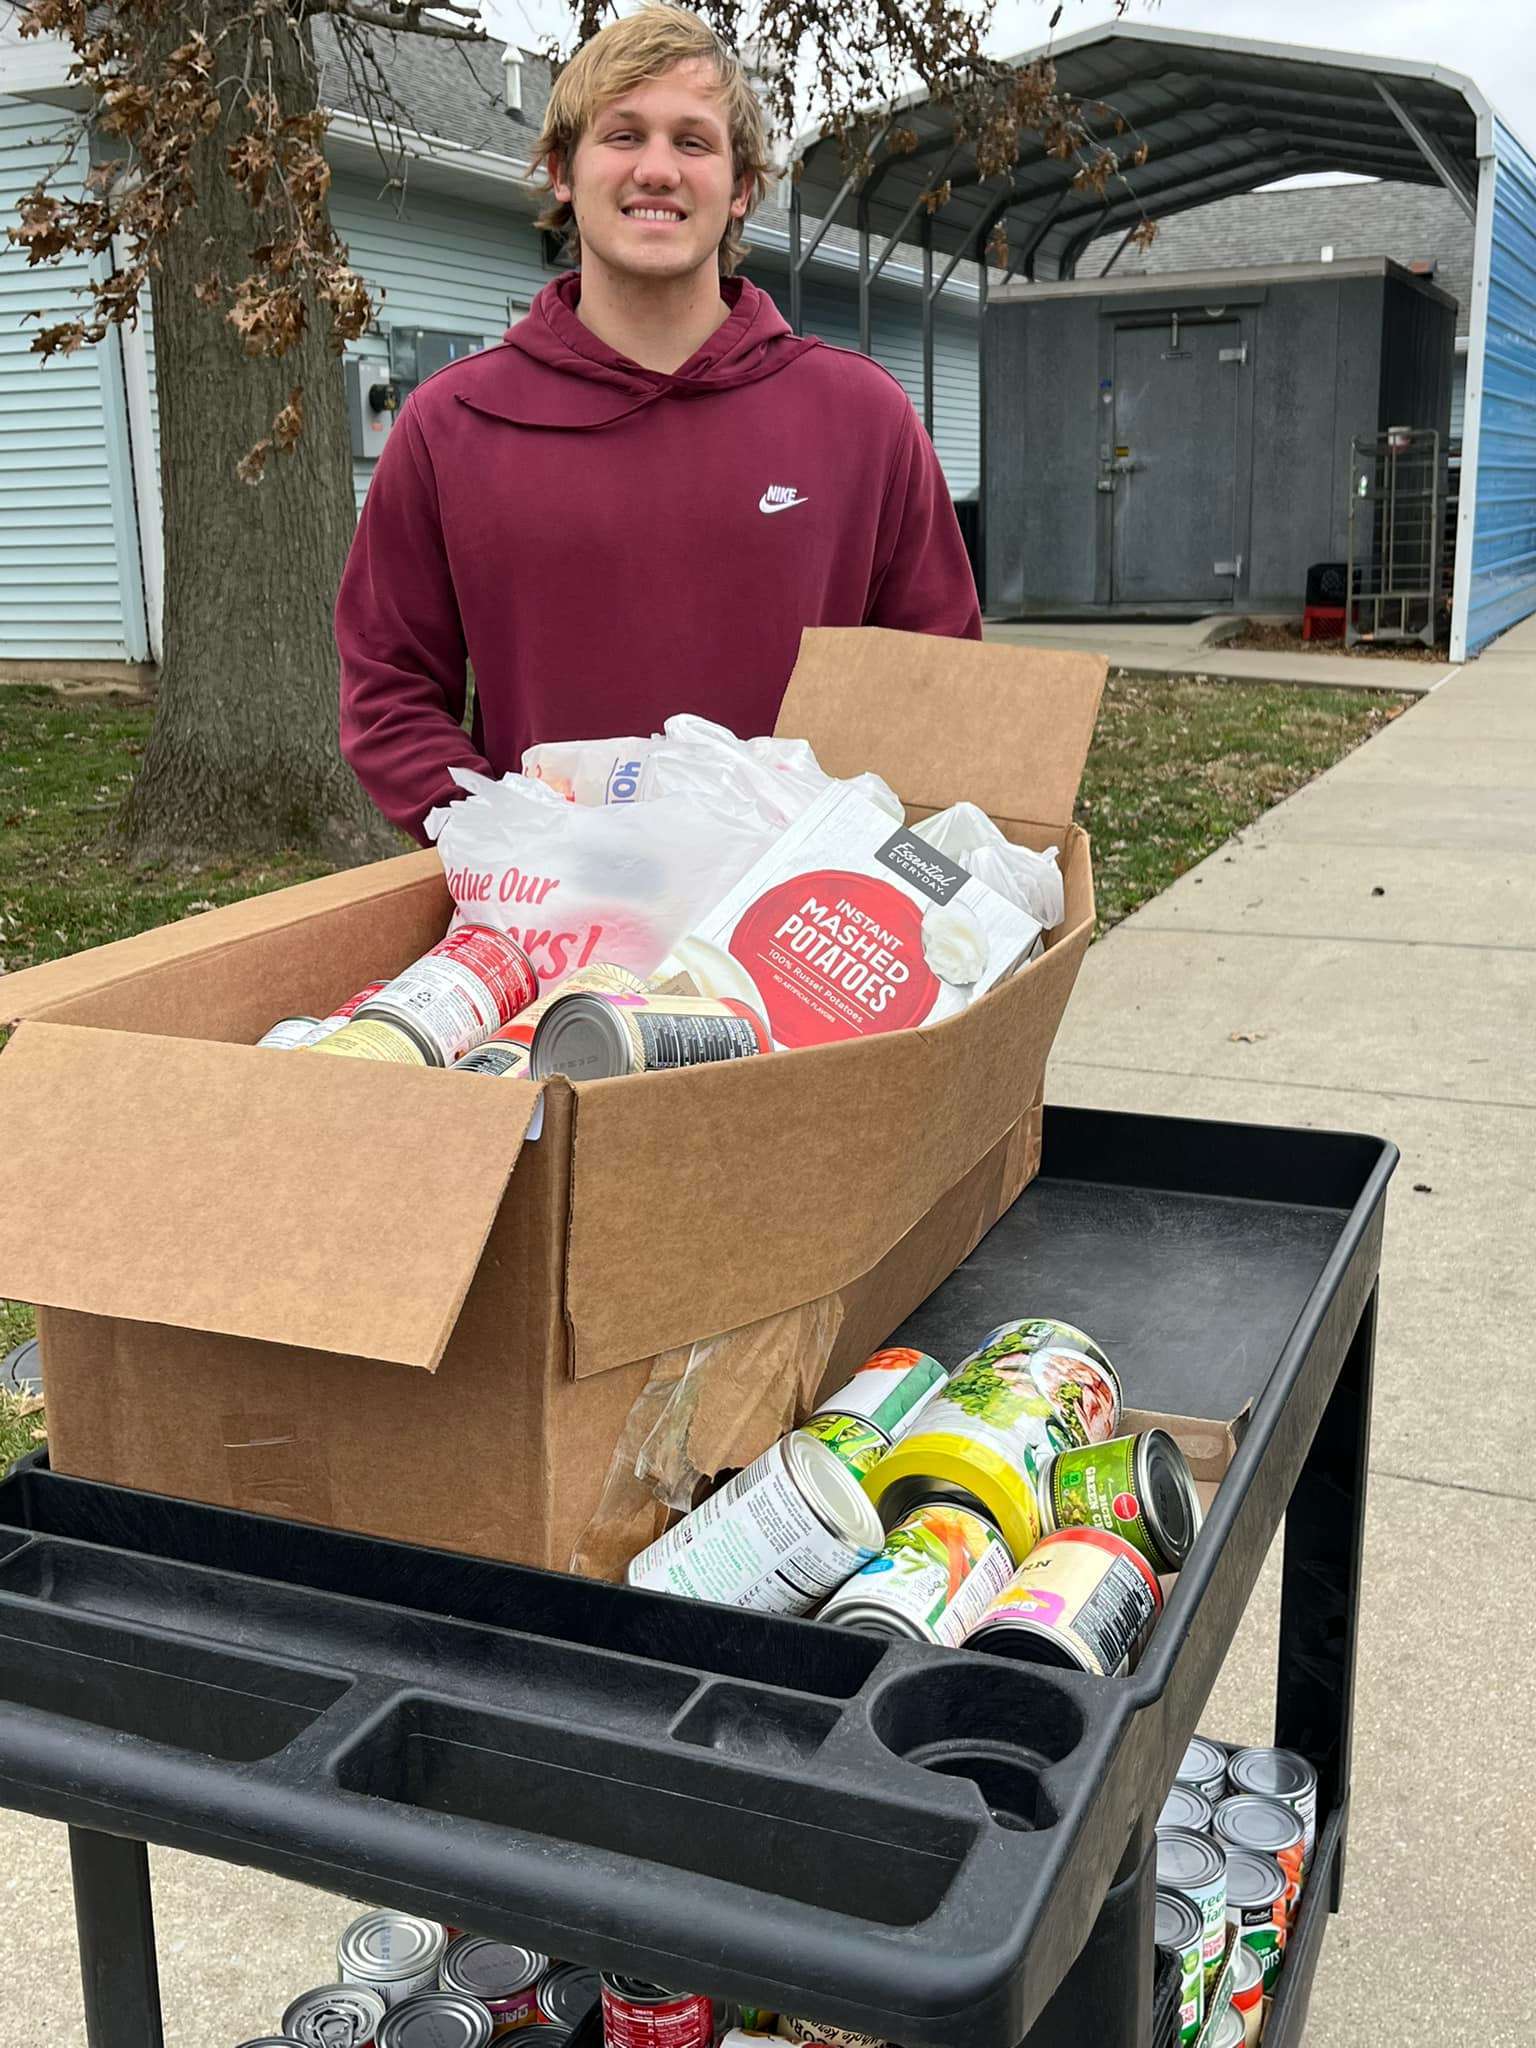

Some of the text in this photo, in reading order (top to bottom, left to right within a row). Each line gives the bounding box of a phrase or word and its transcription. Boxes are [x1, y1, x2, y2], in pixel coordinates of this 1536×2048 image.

[766, 485, 797, 503] NIKE
[499, 867, 560, 905] Our
[891, 843, 957, 888] Essential
[799, 897, 914, 987] MASHED
[834, 898, 904, 951] INSTANT
[768, 949, 865, 1023] 100% Russet Potatoes
[774, 914, 898, 1015] POTATOES
[781, 979, 812, 1005] ARTIFICIAL
